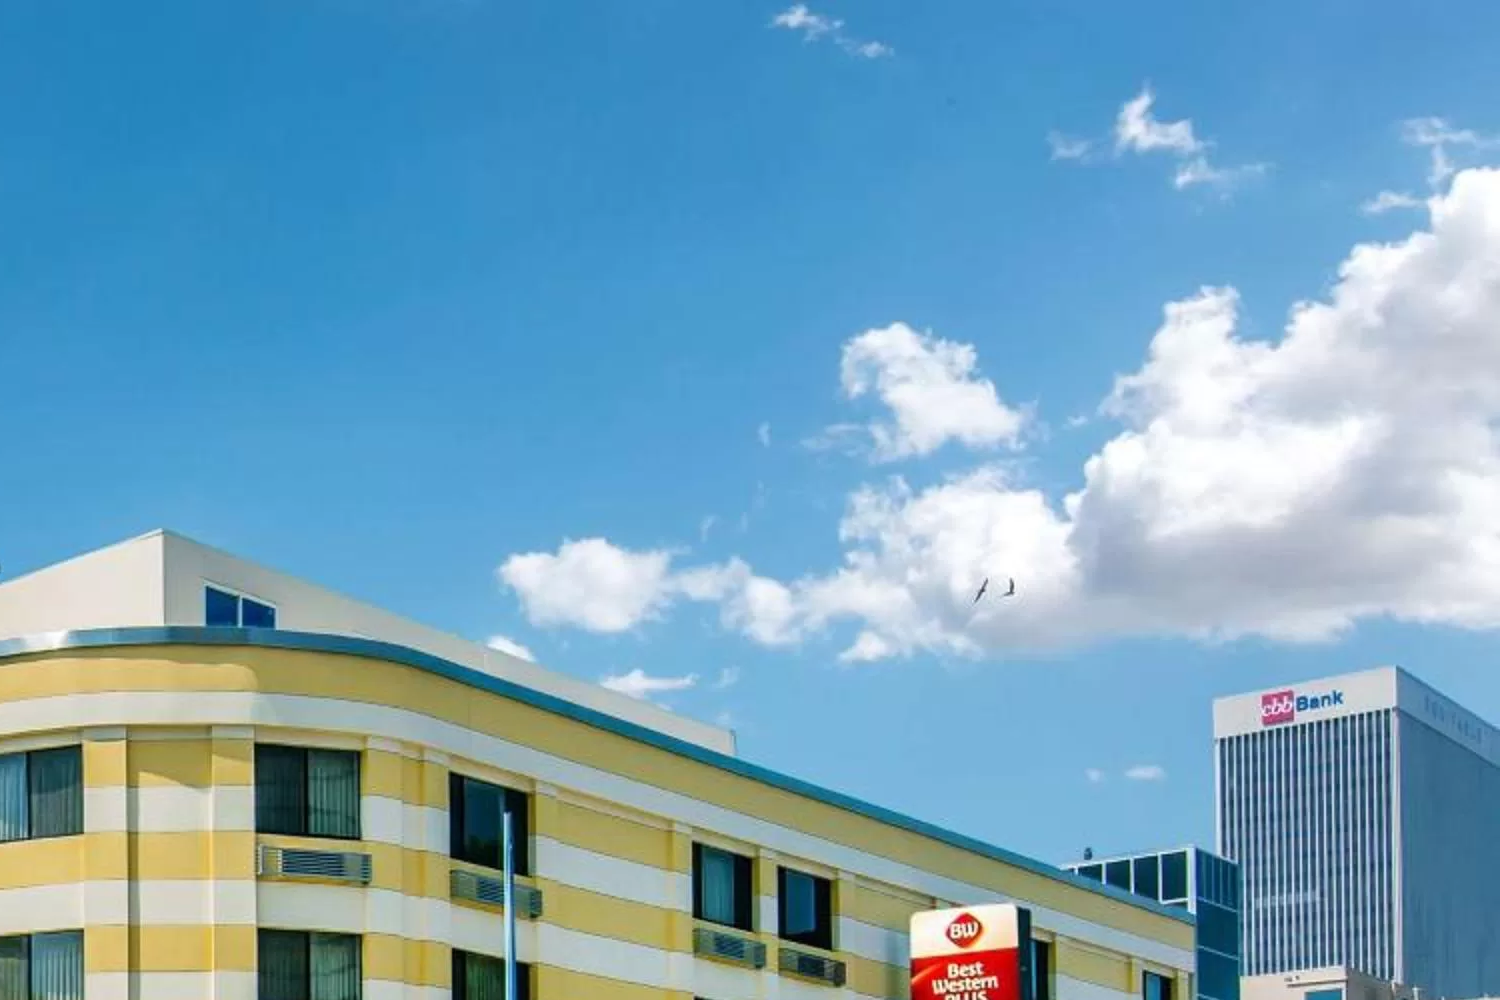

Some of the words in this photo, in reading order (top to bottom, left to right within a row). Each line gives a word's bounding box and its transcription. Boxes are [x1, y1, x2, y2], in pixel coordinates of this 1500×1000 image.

[1296, 689, 1344, 712] Bank
[950, 922, 980, 940] BW
[947, 961, 985, 979] Best
[931, 975, 999, 995] Western
